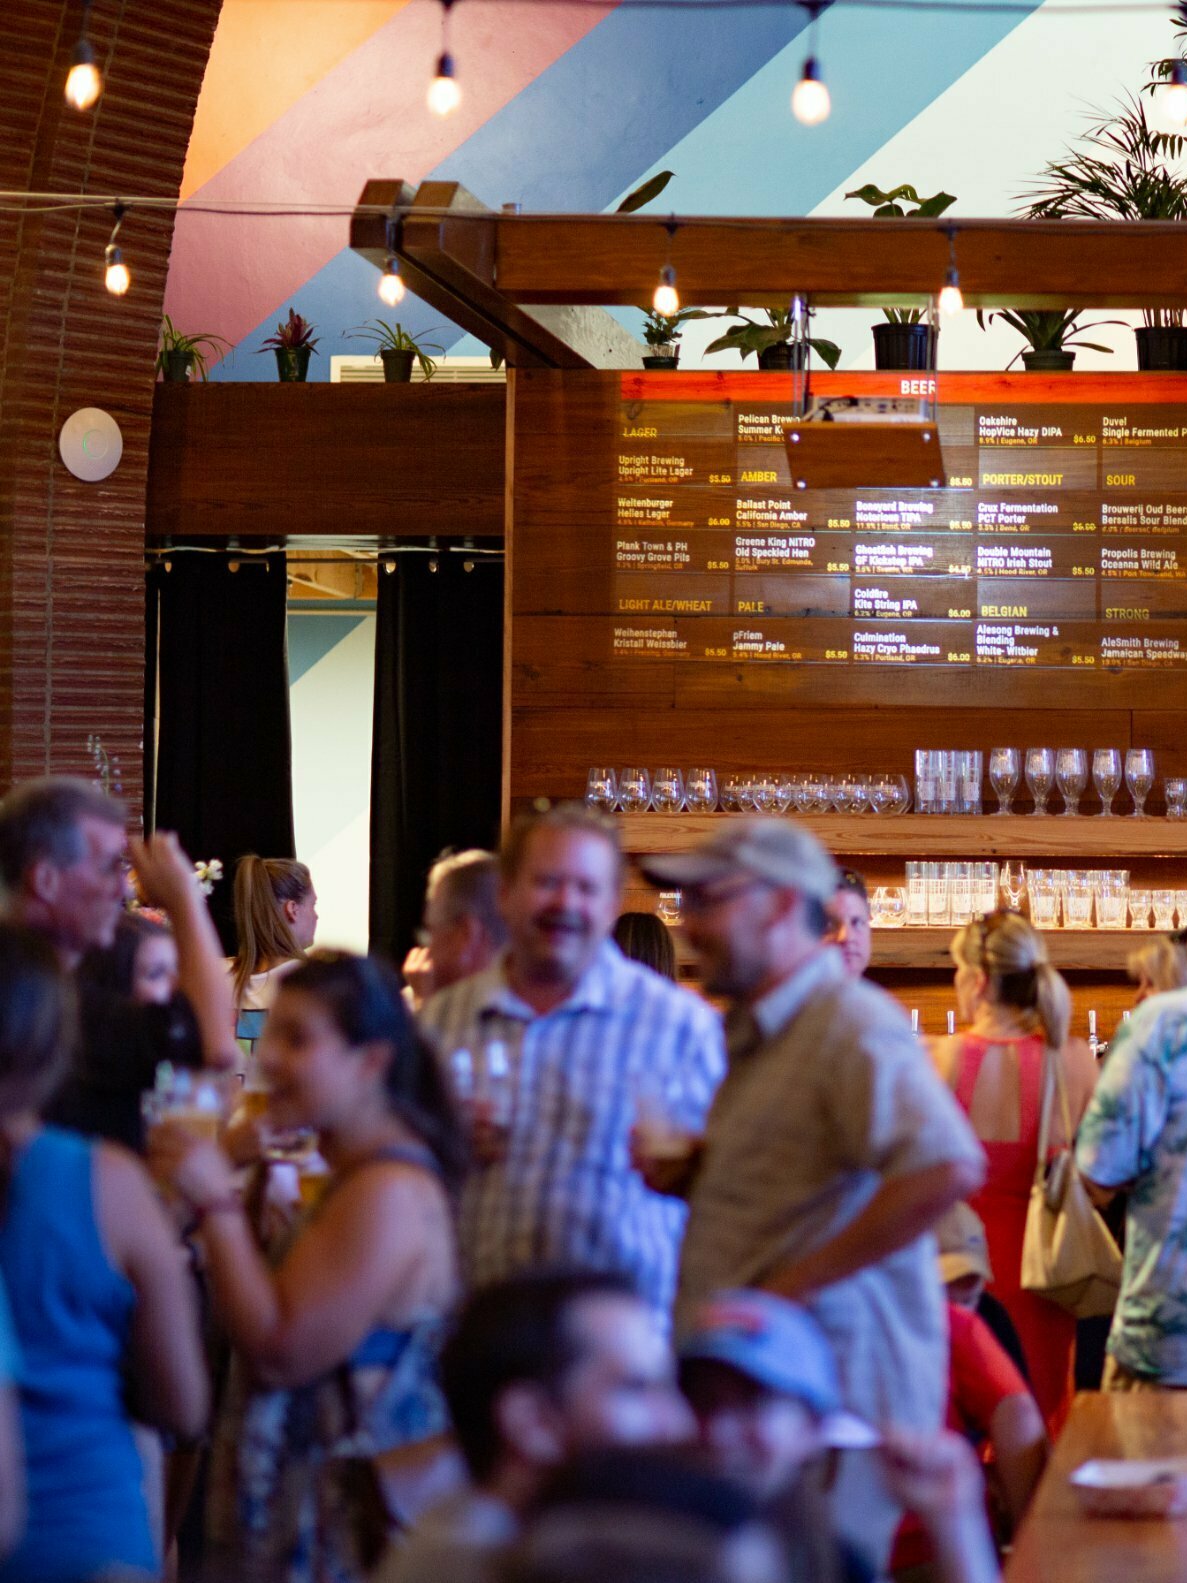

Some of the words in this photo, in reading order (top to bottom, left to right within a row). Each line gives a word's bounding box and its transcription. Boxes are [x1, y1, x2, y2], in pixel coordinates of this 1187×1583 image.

[901, 380, 936, 394] BEER
[738, 414, 769, 423] Pelican
[980, 416, 1017, 425] Oakshire
[1103, 417, 1127, 426] Duvel
[738, 425, 772, 434] Summer
[980, 427, 1015, 437] HopVice
[1018, 428, 1038, 438] Hazy
[1042, 428, 1062, 436] DIPA
[1103, 428, 1129, 438] Single
[1132, 428, 1178, 437] Fermented
[1073, 435, 1096, 444] $6.50
[619, 456, 649, 466] Upright
[651, 456, 684, 466] Brewing
[619, 467, 648, 476] Upright
[651, 467, 667, 475] Lite
[670, 467, 693, 477] Lager
[741, 472, 777, 482] AMBER
[983, 474, 1063, 486] PORTER/STOUT
[1106, 475, 1135, 486] SOUR
[737, 500, 765, 509] Ballast
[768, 500, 790, 509] Point
[1000, 503, 1058, 512] Fermentation
[1102, 504, 1143, 515] Brouwerij
[1146, 504, 1163, 513] Oud
[647, 510, 670, 519] Lager
[736, 511, 777, 519] California
[780, 512, 807, 520] Amber
[978, 513, 996, 523] PCT
[998, 514, 1026, 523] Porter
[828, 520, 850, 528] $5.50
[1102, 515, 1137, 524] Bersalis
[1140, 516, 1160, 524] Sour
[1163, 516, 1187, 525] Blend
[617, 542, 639, 550] Plank
[643, 542, 664, 551] Town
[667, 542, 672, 551] &
[675, 543, 687, 551] PH
[736, 538, 765, 546] Greene
[768, 538, 787, 548] King
[789, 538, 815, 547] NITRO
[736, 548, 749, 556] Old
[752, 548, 790, 558] Speckled
[792, 549, 808, 557] Hen
[978, 547, 1008, 556] Double
[1010, 548, 1051, 557] Mountain
[1102, 549, 1137, 559] Propolis
[1141, 549, 1175, 560] Brewing
[617, 553, 645, 562] Groovy
[648, 553, 671, 561] Grove
[674, 553, 690, 562] Pils
[708, 561, 728, 569] $5.50
[827, 563, 849, 571] $5.50
[977, 558, 1004, 567] NITRO
[1007, 558, 1026, 567] Irish
[1028, 559, 1052, 568] Stout
[1101, 559, 1139, 568] Oceanna
[1142, 560, 1160, 569] Wild
[1164, 560, 1178, 569] Ale
[1072, 567, 1094, 575] $5.50
[619, 600, 650, 610] LIGHT
[652, 600, 712, 611] ALE/WHEAT
[738, 602, 764, 612] PALE
[855, 599, 872, 609] Kite
[875, 600, 900, 611] String
[903, 600, 917, 610] IPA
[982, 606, 1027, 617] BELGIAN
[1106, 608, 1149, 620] STRONG
[614, 628, 677, 638] Weihenstephan
[733, 631, 762, 640] pFriem
[977, 625, 1012, 636] Alesong
[1014, 626, 1050, 637] Brewing
[1052, 627, 1059, 636] &
[854, 633, 906, 642] Culmination
[977, 635, 1014, 646] Blending
[647, 640, 687, 649] Weissbier
[733, 642, 763, 651] Jammy
[766, 642, 784, 650] Pale
[1102, 637, 1141, 647] AleSmith
[1144, 638, 1179, 649] Brewing
[854, 644, 875, 654] Hazy
[877, 644, 897, 654] Cryo
[1102, 648, 1143, 658] Jamaican
[1072, 656, 1094, 664] $5.50
